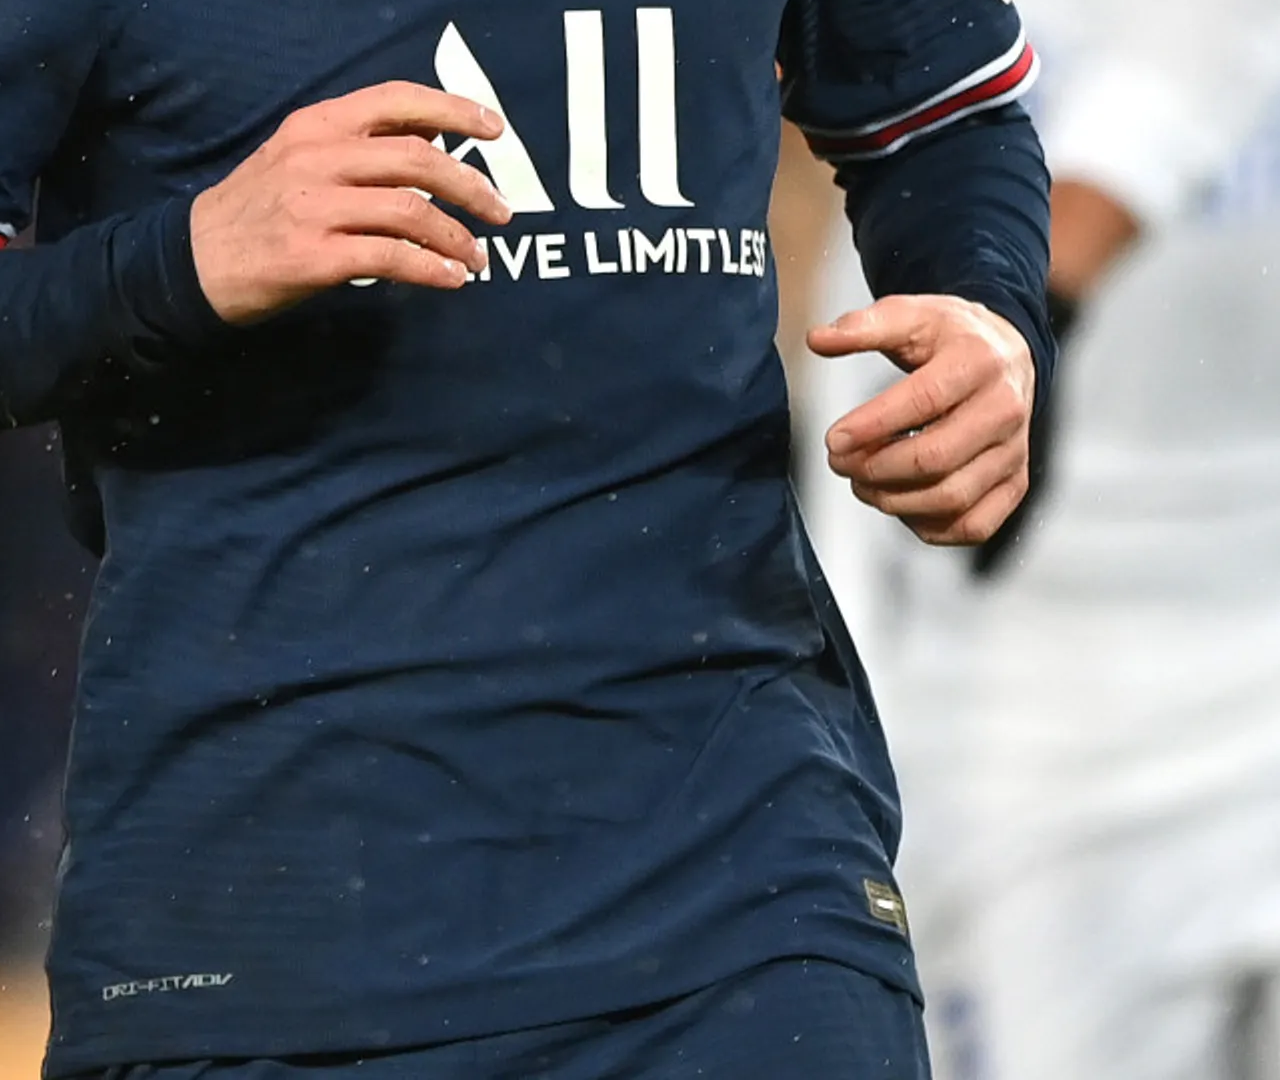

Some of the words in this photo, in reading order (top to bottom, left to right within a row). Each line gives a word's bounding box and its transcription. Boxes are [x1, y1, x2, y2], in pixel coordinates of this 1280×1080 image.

[406, 7, 696, 214] All
[465, 232, 571, 282] IVE
[584, 227, 766, 278] LIMITLESS
